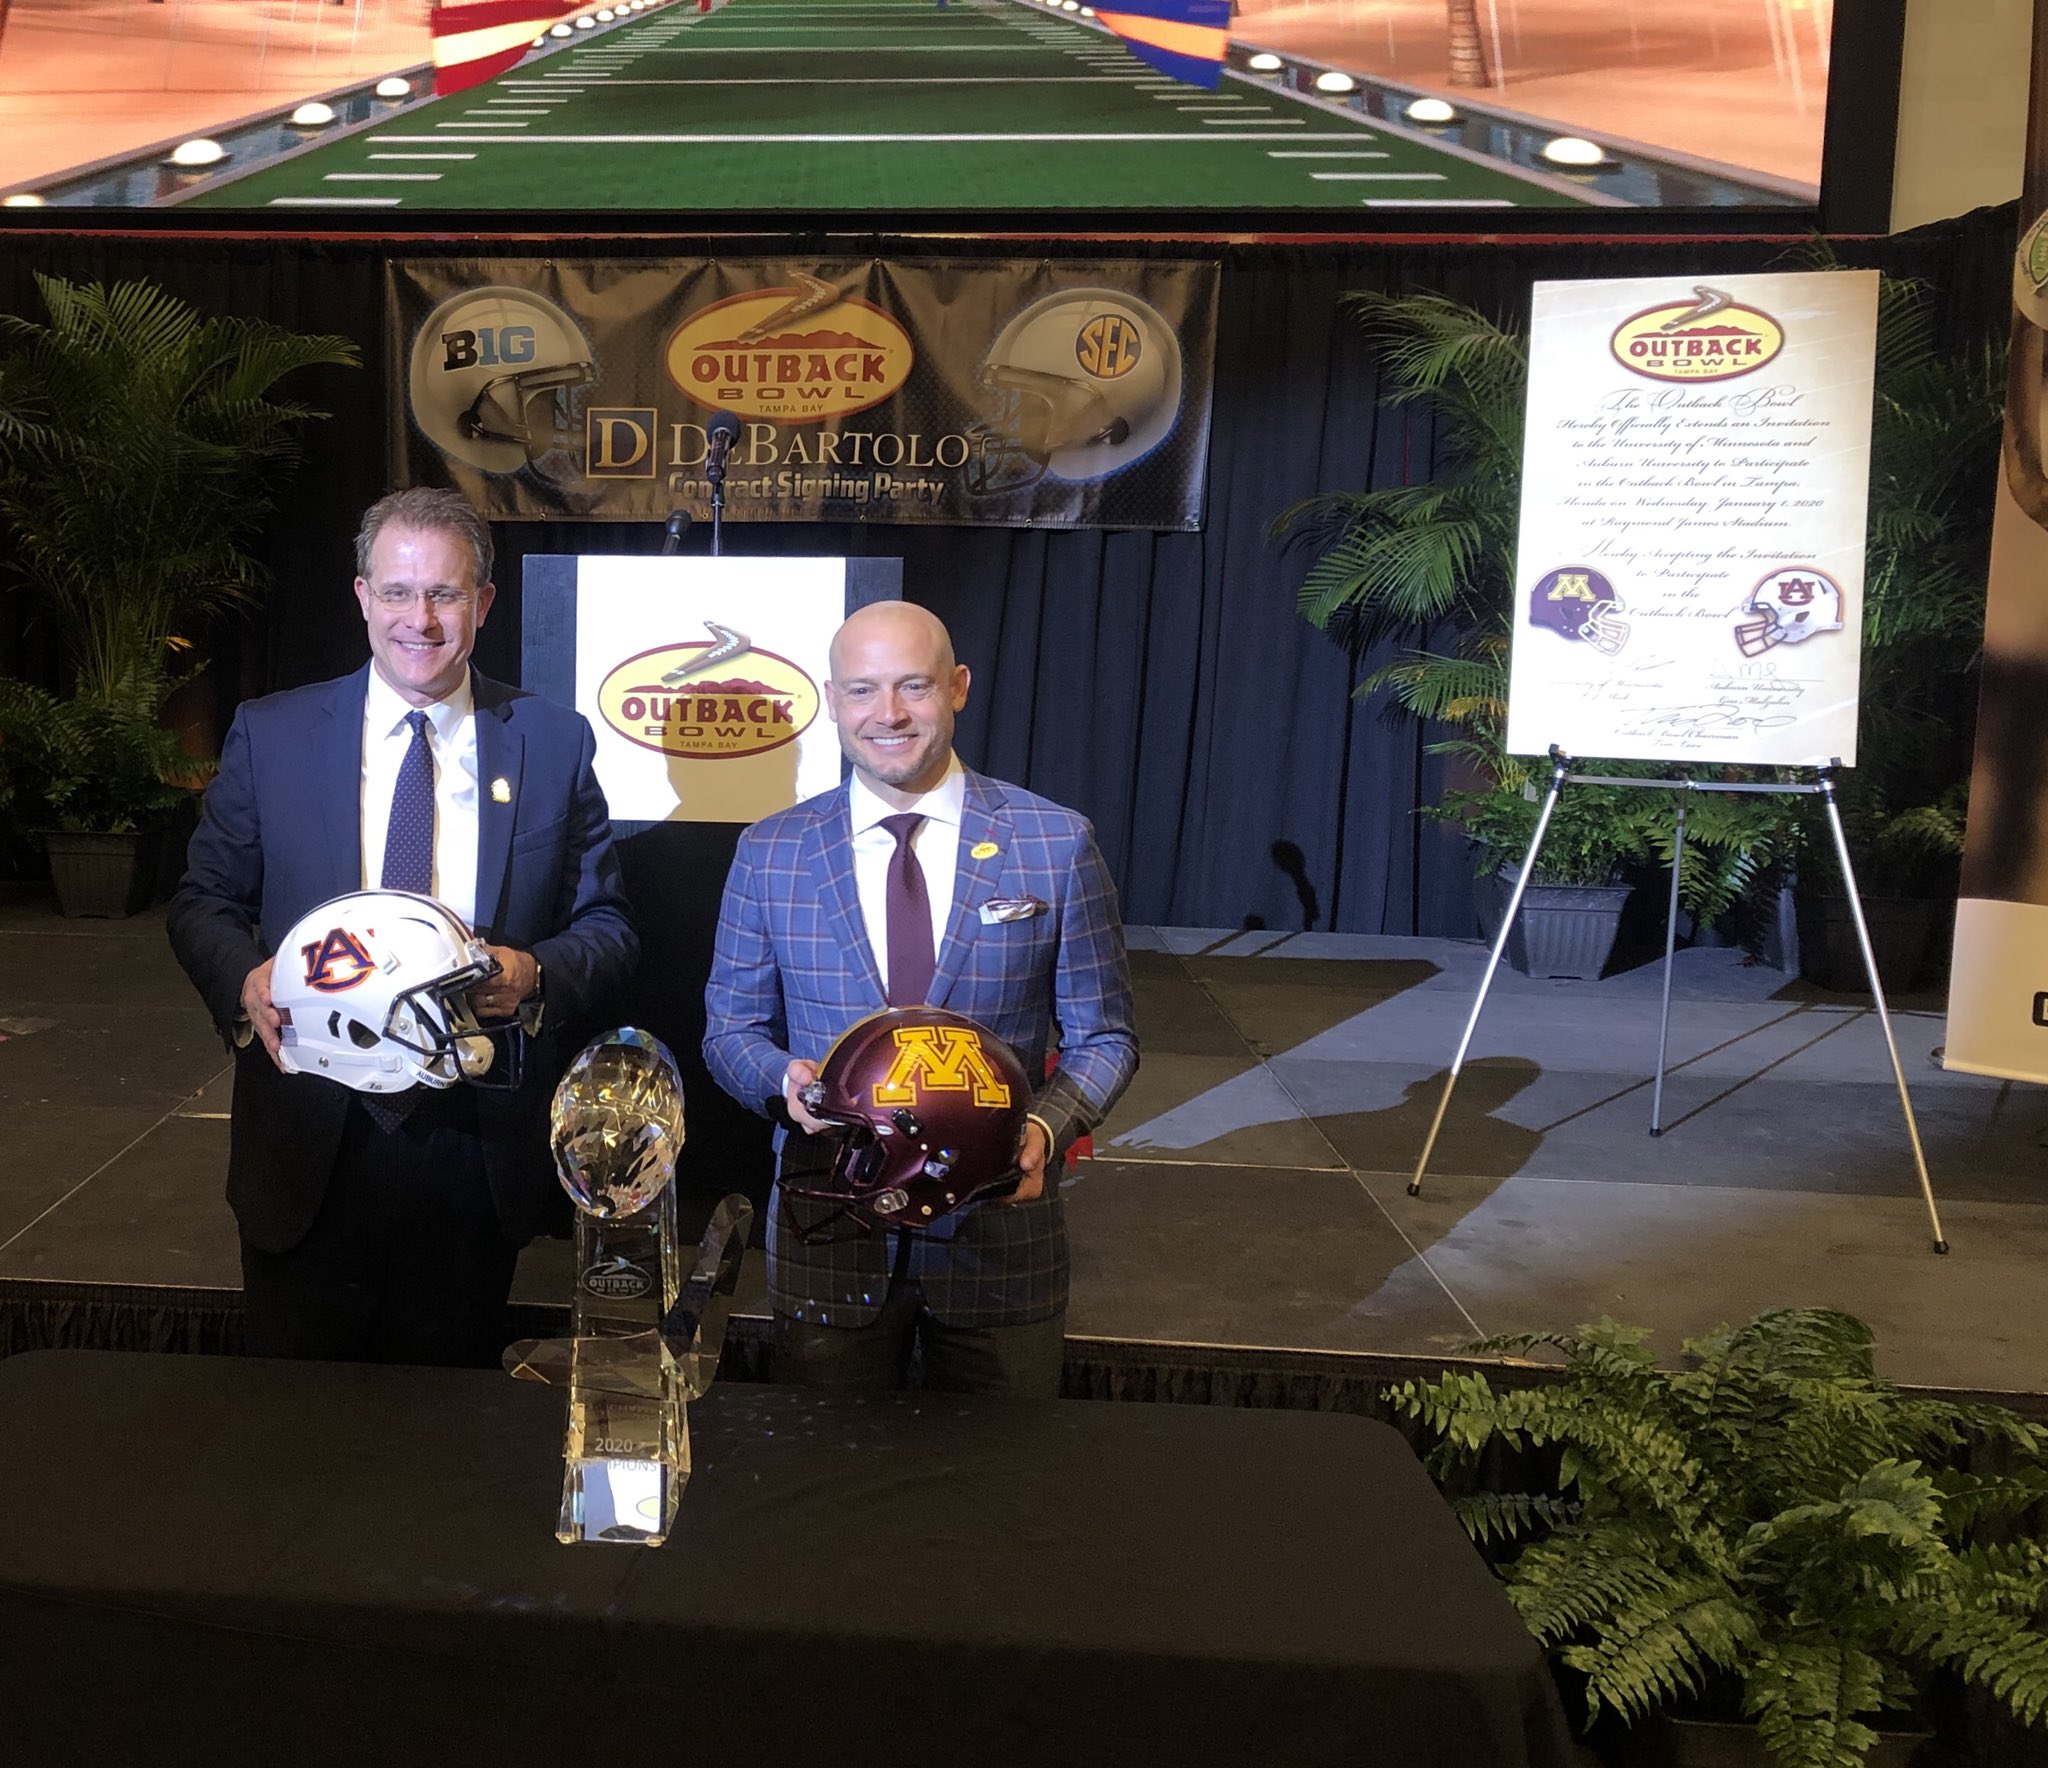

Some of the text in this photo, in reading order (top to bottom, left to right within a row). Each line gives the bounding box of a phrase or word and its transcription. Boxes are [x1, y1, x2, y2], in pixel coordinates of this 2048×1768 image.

[1080, 315, 1139, 377] SEC
[1629, 338, 1762, 357] OUTBACK
[691, 353, 885, 383] OUTBACK
[1646, 358, 1748, 368] BOWL
[717, 387, 865, 400] BOWL
[1603, 385, 1804, 416] The Outback Bowl
[759, 404, 824, 413] TAMPA BAY
[1557, 417, 1606, 434] Hereby
[1731, 420, 1750, 428] an
[1753, 416, 1831, 428] Invitation
[595, 418, 648, 468] D
[1587, 437, 1606, 448] the
[1612, 437, 1682, 454] University
[1685, 435, 1703, 455] of
[1702, 436, 1780, 448] Minnesota
[1783, 436, 1818, 448] and
[1639, 458, 1710, 475] University
[1713, 459, 1726, 467] to
[1730, 457, 1810, 475] Participate
[669, 471, 945, 503] Conract Signing Party
[1595, 477, 1615, 488] the
[1678, 477, 1720, 488] Bowl
[1712, 497, 1777, 514] January
[1791, 500, 1824, 508] 2020
[1600, 517, 1671, 534] Raymond
[1675, 517, 1719, 532] James
[1717, 547, 1737, 559] the
[1740, 547, 1817, 560] Invitation
[1548, 574, 1596, 602] M
[621, 697, 794, 724] OUTBACK
[644, 726, 776, 738] BOWL
[680, 741, 738, 749] TAMPA BAY
[872, 1026, 1011, 1108] M
[416, 1070, 446, 1088] AUBURN
[589, 1278, 644, 1289] OUTBACK
[594, 1438, 633, 1453] 2020
